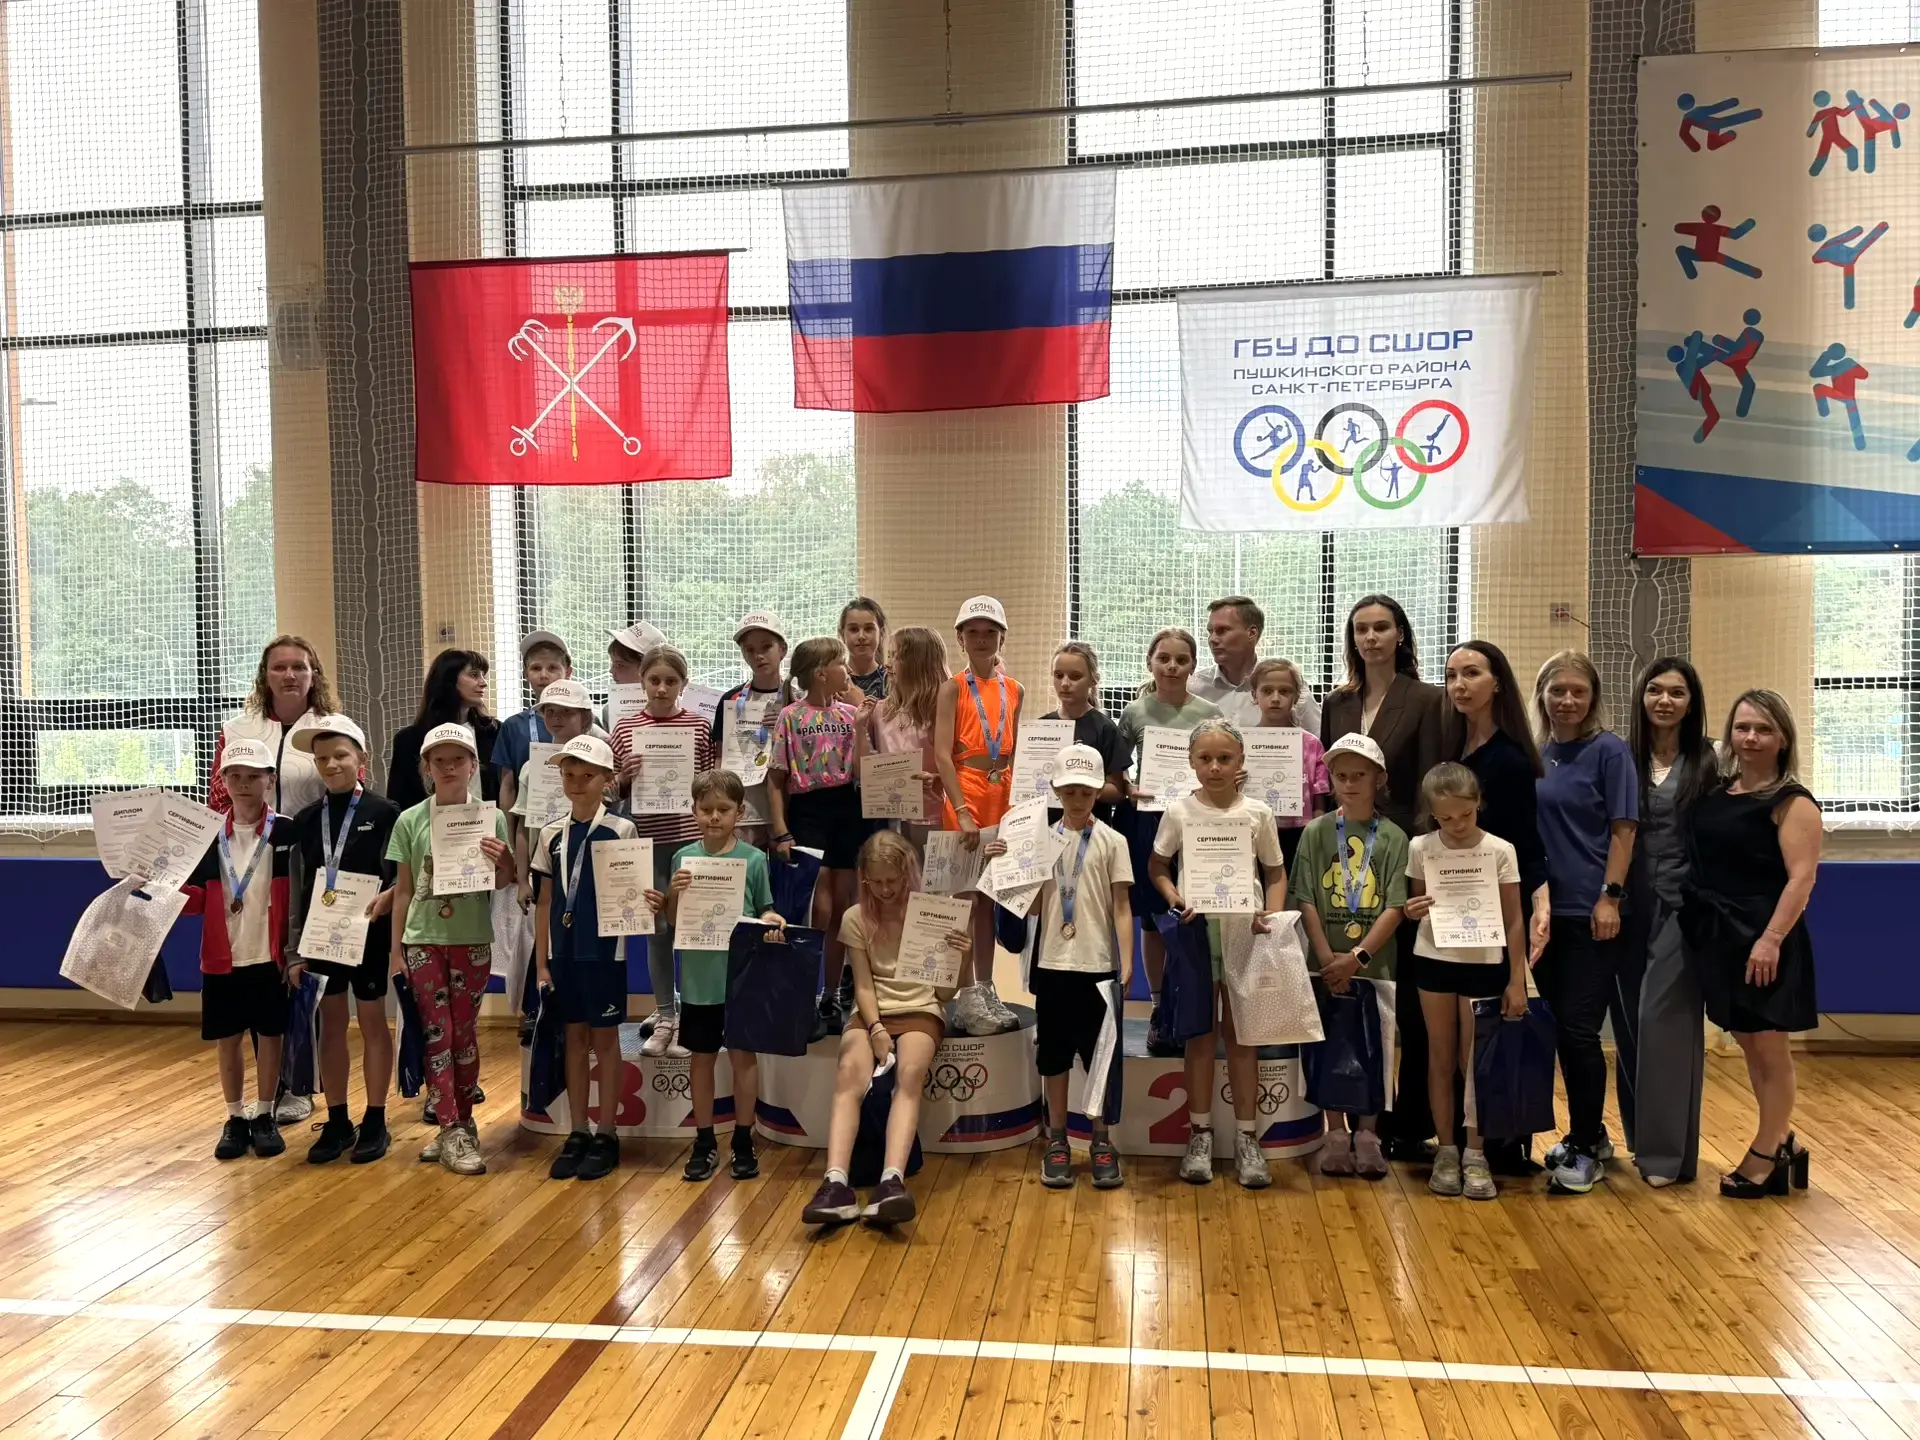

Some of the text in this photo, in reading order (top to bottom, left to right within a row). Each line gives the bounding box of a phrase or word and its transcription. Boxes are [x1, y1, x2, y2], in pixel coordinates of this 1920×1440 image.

[1234, 329, 1473, 359] ГБУ ДО СШОР
[1233, 359, 1472, 380] ПУШКИНСКОГО РАЙОНА
[1251, 377, 1453, 396] САНКТ-ПЕТЕРБУРГА
[802, 723, 851, 737] PARADISE
[113, 807, 143, 816] ДИПЛОМ
[168, 810, 205, 831] СЕРТИФИКАТ
[446, 819, 484, 828] СЕРТИФИКАТ
[609, 860, 634, 869] ДИПЛОМ
[1439, 867, 1482, 876] СЕРТИФИКАТ
[693, 874, 732, 882] СЕРТИФИКАТ
[919, 911, 958, 922] СЕРТИФИКАТ
[951, 1043, 985, 1052] СШОР
[1148, 1071, 1192, 1145] 2
